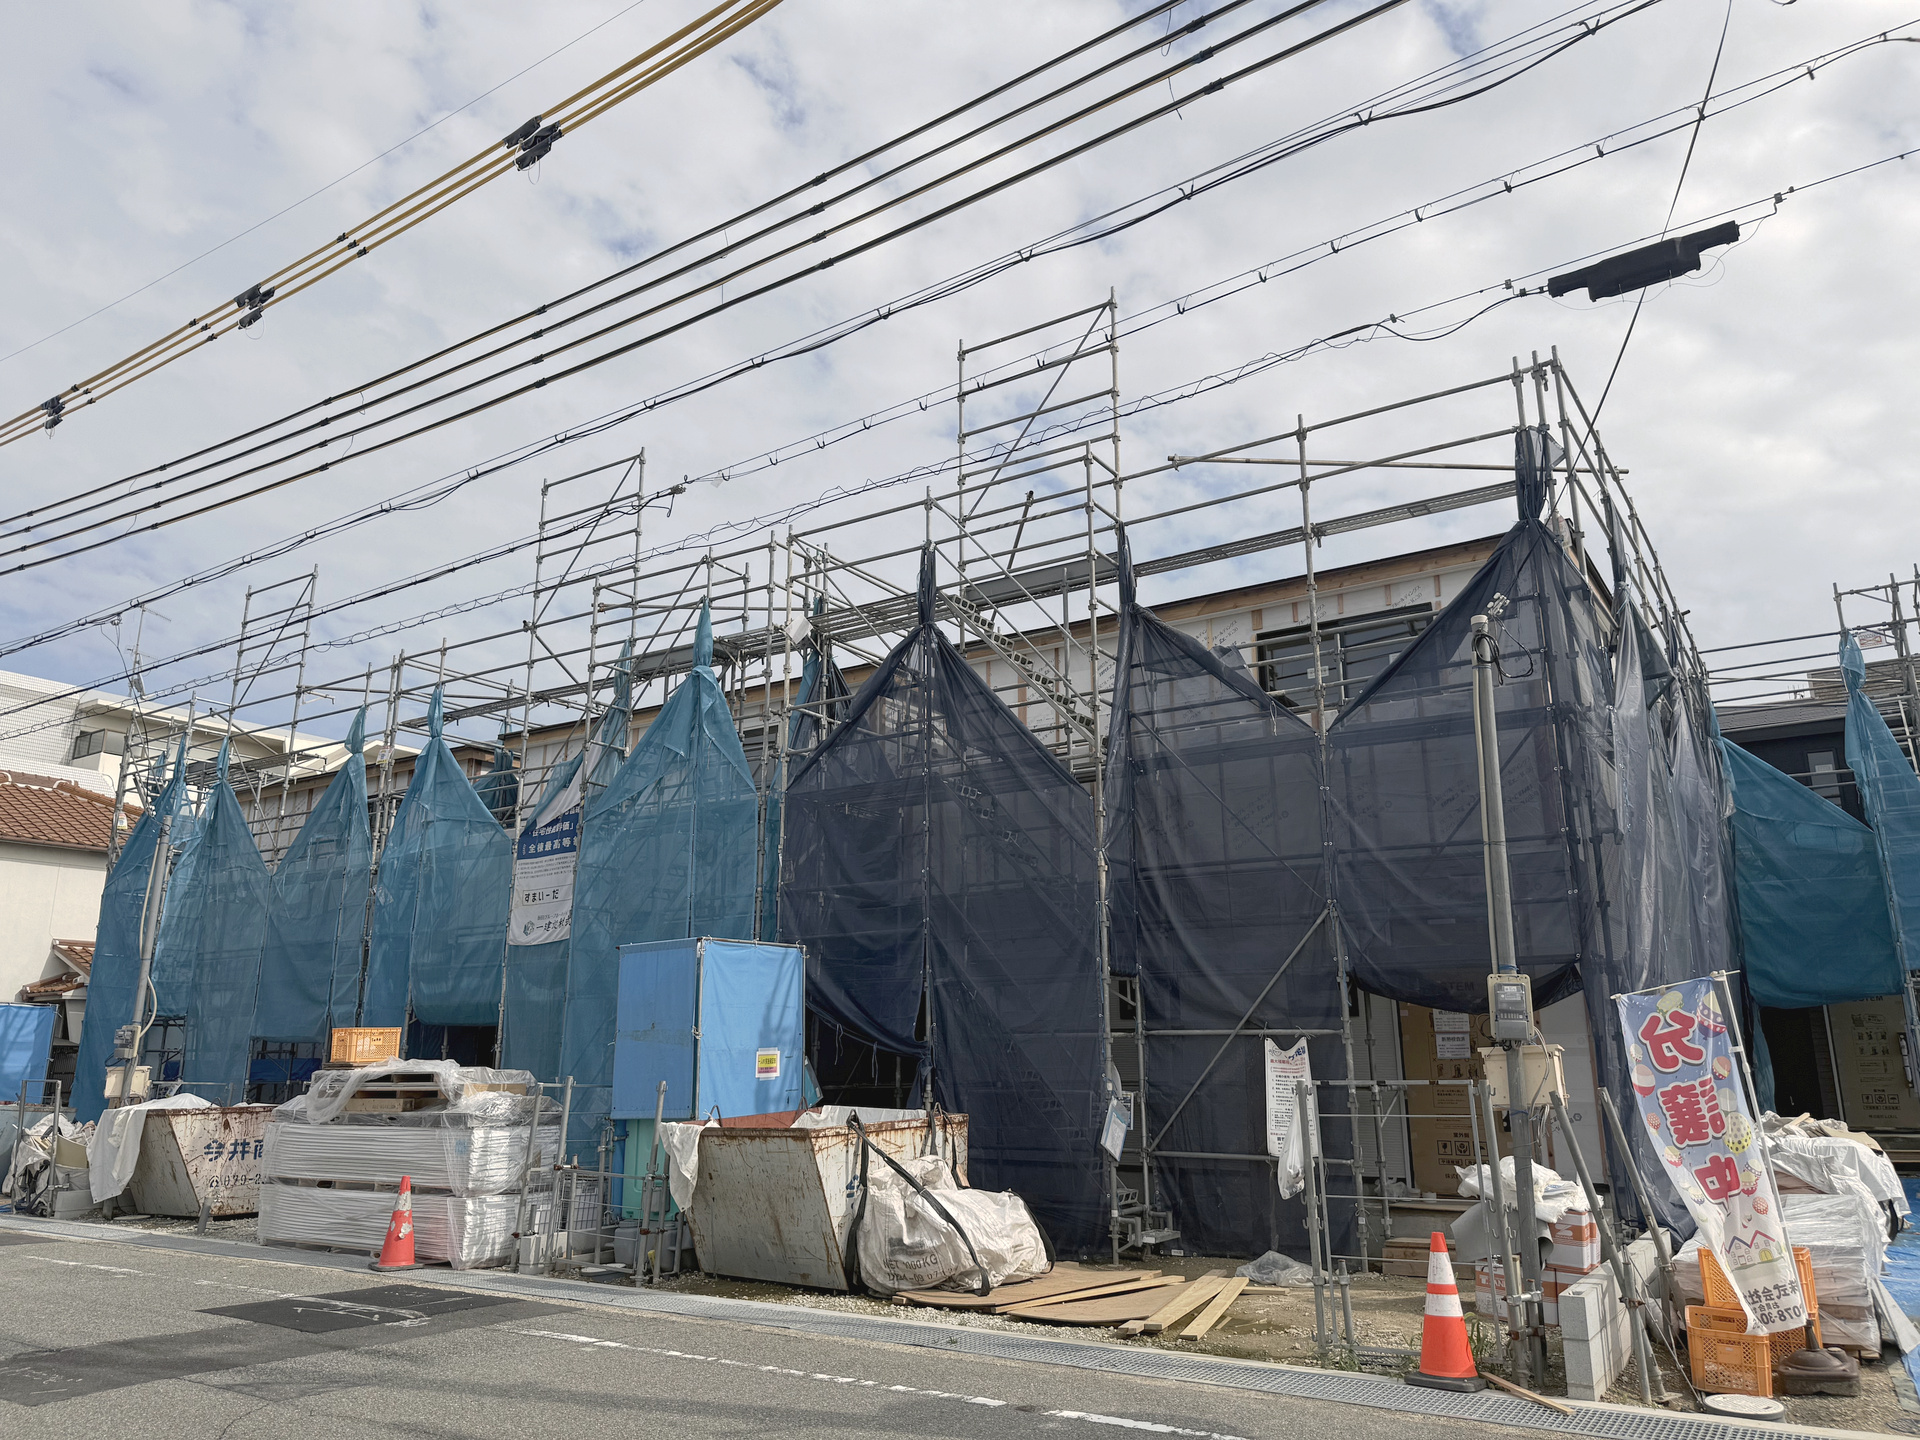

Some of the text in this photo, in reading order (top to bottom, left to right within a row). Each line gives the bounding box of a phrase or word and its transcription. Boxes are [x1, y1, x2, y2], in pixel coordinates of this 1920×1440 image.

[524, 889, 559, 903] すまいーだ
[224, 1173, 265, 1186] 079-2
